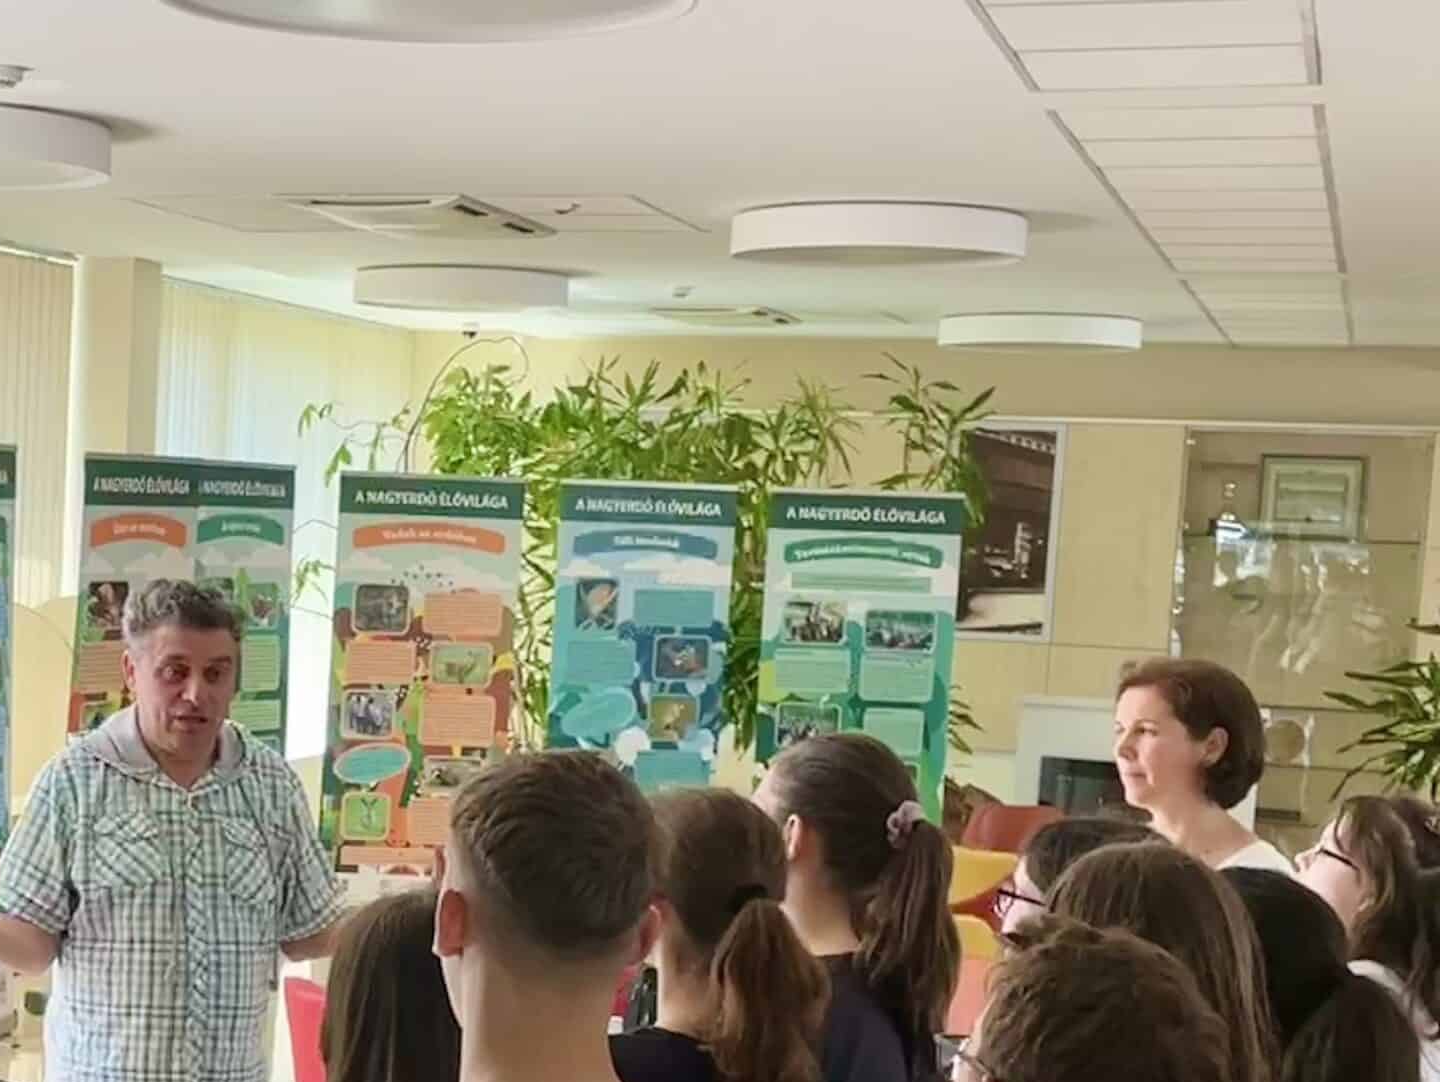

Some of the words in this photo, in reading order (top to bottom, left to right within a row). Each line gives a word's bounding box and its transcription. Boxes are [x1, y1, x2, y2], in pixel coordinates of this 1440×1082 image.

[355, 490, 365, 504] A
[366, 489, 437, 506] NAGYERDŐ
[439, 490, 509, 509] ÉLŐVILÁGA
[575, 498, 586, 511] A
[586, 497, 653, 513] NAGYERDŐ
[655, 498, 721, 516] ÉLŐVILÁGA
[786, 507, 797, 519] A
[798, 506, 871, 522] NAGYERDŐ
[873, 506, 946, 524] ÉLŐVILÁGA
